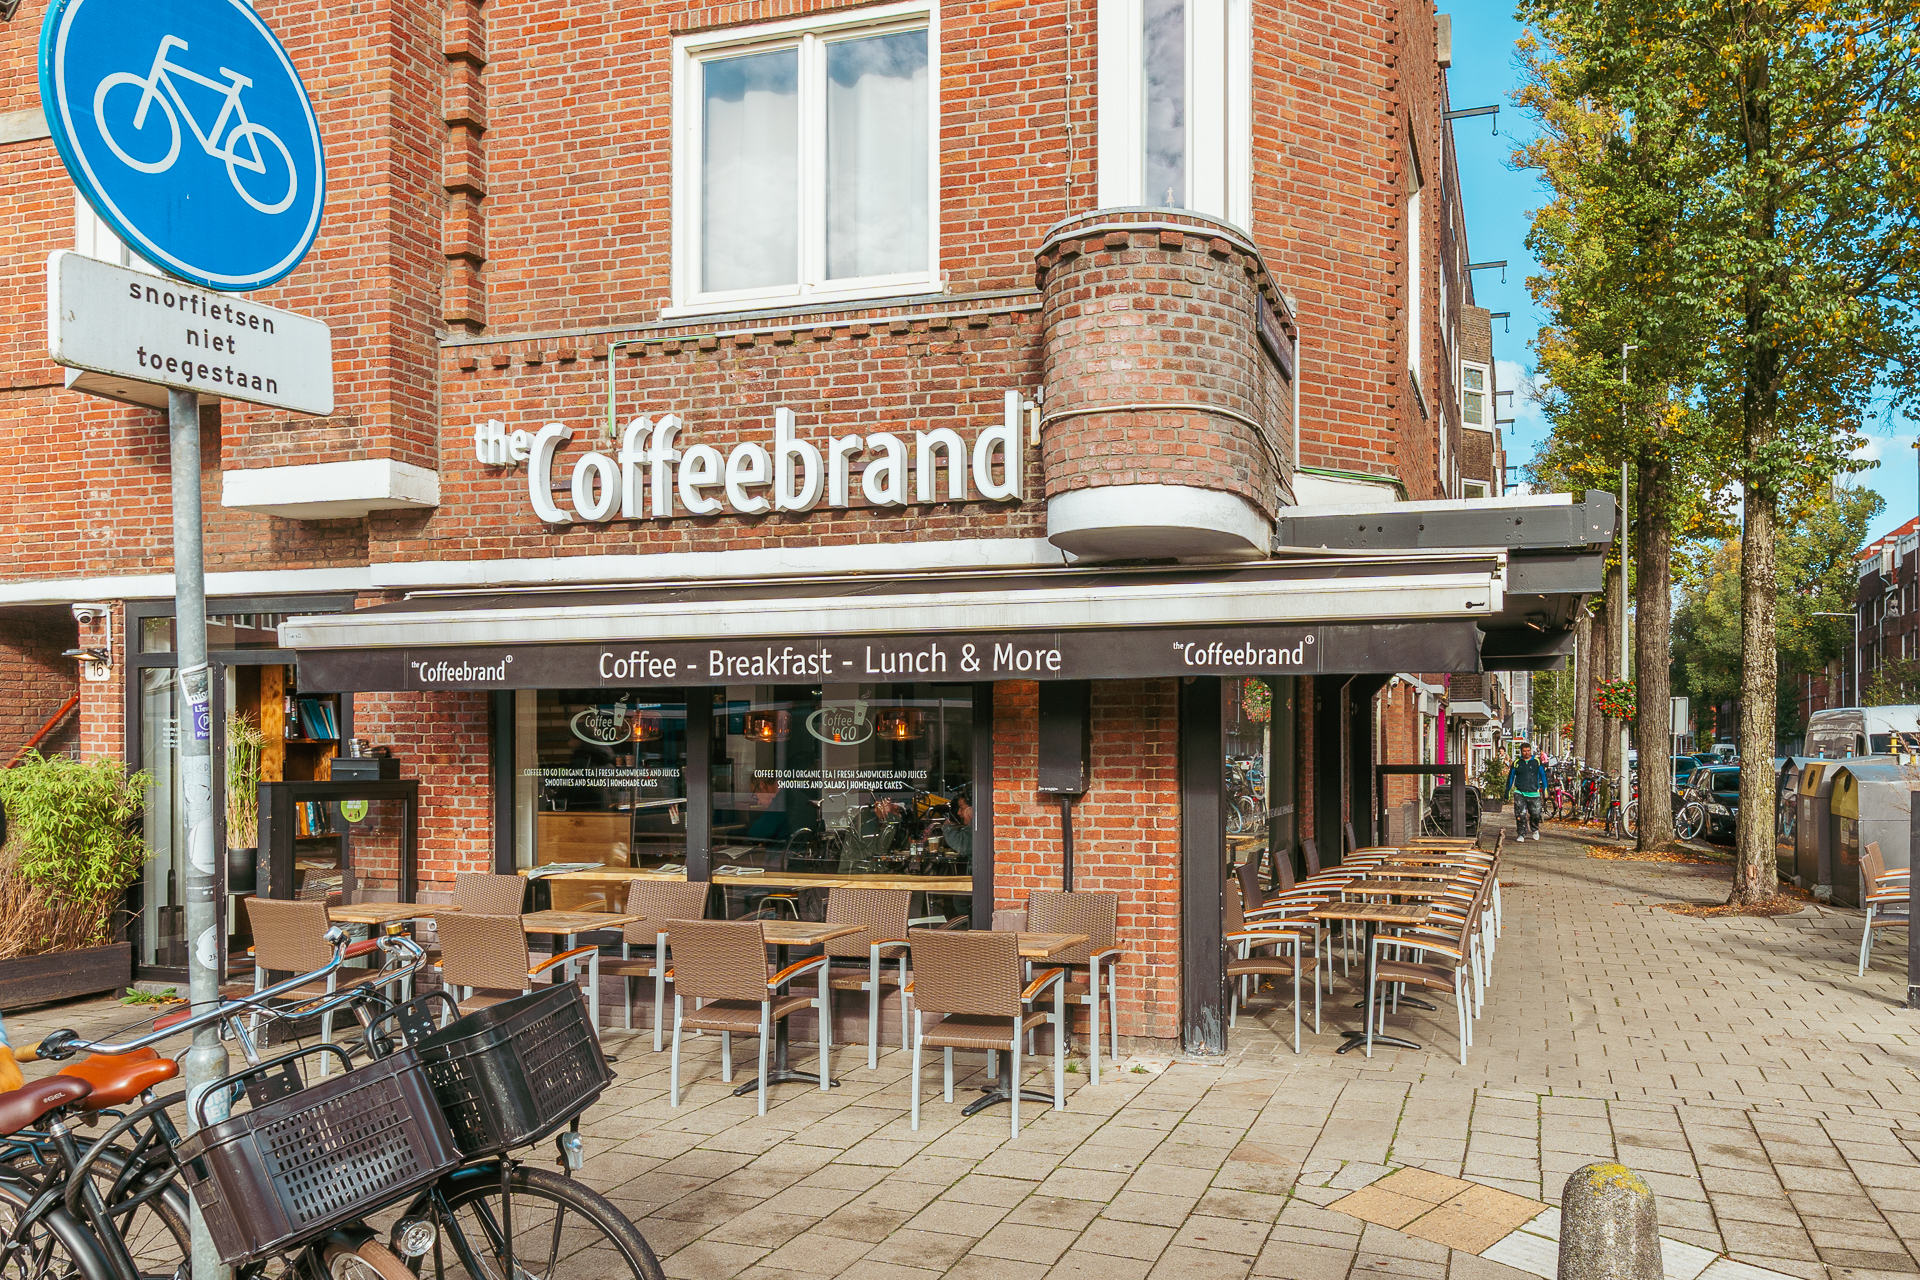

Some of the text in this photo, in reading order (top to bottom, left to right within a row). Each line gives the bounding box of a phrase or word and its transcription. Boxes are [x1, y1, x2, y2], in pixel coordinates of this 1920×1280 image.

[130, 283, 274, 334] snorfietsen
[186, 329, 235, 354] niet
[136, 346, 278, 394] toegestaan
[474, 390, 1024, 524] the Coffeebrand
[599, 650, 676, 678] Coffee
[710, 647, 832, 677] Breakfast
[866, 643, 946, 674] Lunch
[960, 642, 980, 672] &
[992, 642, 1061, 672] More
[91, 662, 104, 676] 16
[585, 715, 612, 727] Coffee
[822, 714, 852, 726] Coffee
[524, 769, 542, 777] COFFEE
[543, 769, 550, 777] TO
[550, 769, 558, 777] GO
[561, 769, 584, 777] ORGANIC
[585, 769, 594, 777] TEA
[599, 769, 614, 777] FRESH
[616, 769, 649, 777] SANDWICHES
[650, 769, 662, 777] AND
[662, 769, 680, 777] JUICES
[754, 770, 774, 778] COFFEE
[775, 770, 782, 778] TO
[783, 770, 791, 778] GO
[796, 770, 820, 778] ORGANIC
[822, 770, 832, 778] TEA
[837, 770, 855, 778] FRESH
[856, 770, 893, 778] SANDWICHES
[894, 770, 907, 778] AND
[907, 770, 927, 778] JUICES
[777, 780, 810, 789] SMOOTHIES
[811, 780, 823, 789] AND
[824, 780, 846, 789] SALADS
[850, 780, 883, 789] HOMEMADE
[884, 780, 903, 789] CAKES
